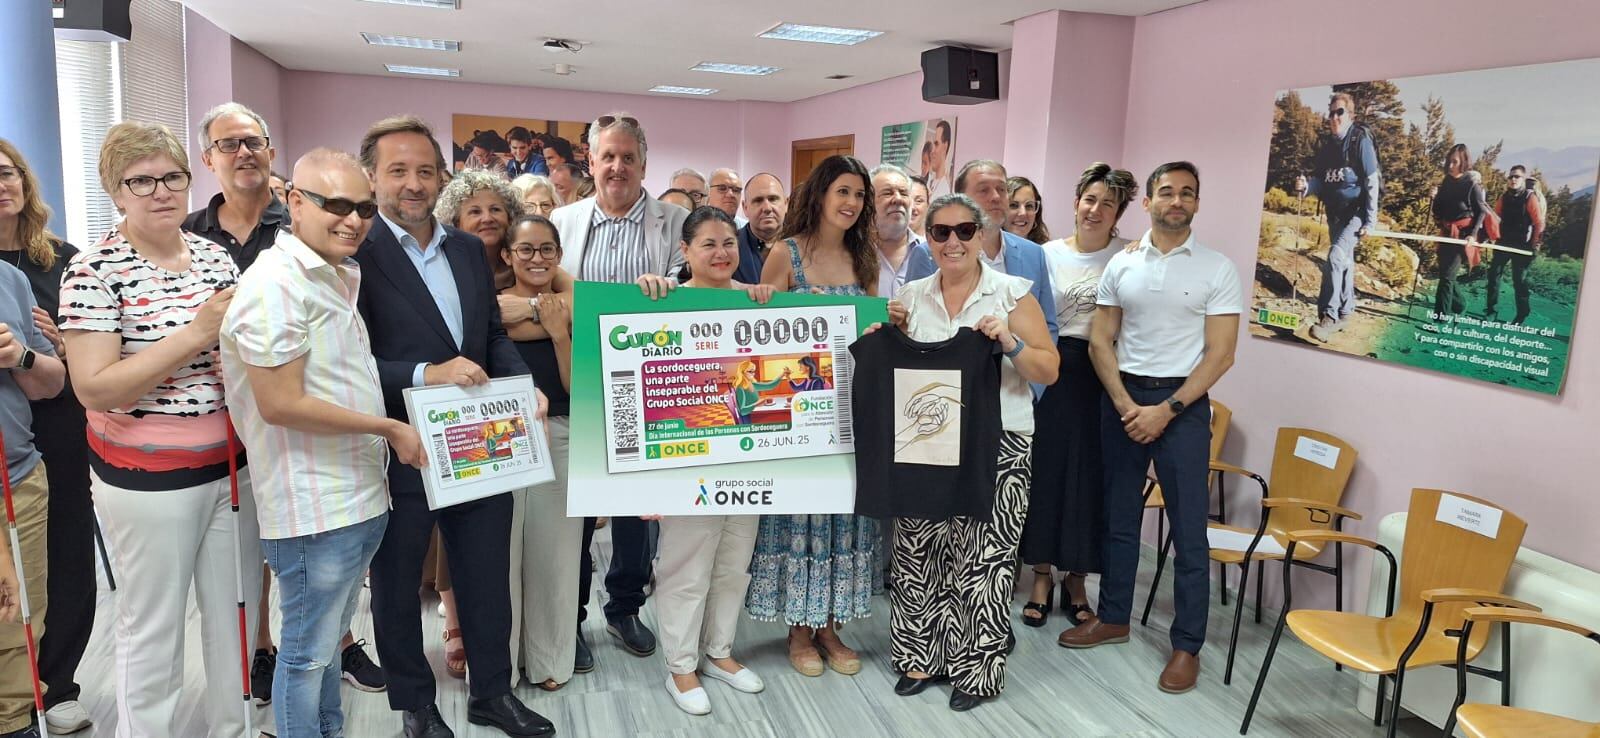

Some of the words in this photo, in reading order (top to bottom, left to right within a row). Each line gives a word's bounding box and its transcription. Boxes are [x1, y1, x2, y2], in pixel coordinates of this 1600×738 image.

[1270, 313, 1296, 326] ONCE
[1426, 310, 1439, 319] No
[1439, 312, 1453, 323] hay
[1481, 320, 1500, 328] para
[1502, 321, 1539, 335] disfrutar
[1540, 327, 1555, 337] del
[690, 322, 722, 338] 000
[733, 316, 828, 346] 00000
[1422, 323, 1440, 333] ocio,
[1442, 325, 1453, 334] de
[1453, 326, 1461, 335] la
[1462, 329, 1492, 342] cultura,
[1494, 333, 1508, 343] del
[1509, 336, 1552, 351] deporte...
[695, 341, 719, 350] SERIE
[1414, 331, 1420, 340] Y
[1420, 335, 1438, 343] para
[1439, 338, 1484, 352] compartirlo
[1485, 346, 1500, 354] con
[1502, 347, 1515, 357] los
[1516, 351, 1550, 365] amigos,
[644, 364, 656, 374] La
[657, 362, 723, 373] sordoceguera,
[1433, 350, 1448, 358] con
[1456, 353, 1468, 361] sin
[1469, 354, 1522, 372] discapacidad
[1523, 365, 1549, 377] visual
[645, 377, 663, 385] una
[665, 374, 689, 385] parte
[646, 385, 701, 397] inseparable
[703, 383, 718, 393] del
[461, 404, 476, 414] 000
[480, 398, 519, 417] 00000
[646, 399, 675, 408] Grupo
[676, 395, 704, 406] Social
[705, 394, 729, 404] ONCE
[800, 399, 834, 411] ONCE
[664, 422, 679, 430] junio
[714, 426, 740, 434] Personas
[751, 423, 788, 432] Sordoceguera
[758, 439, 770, 447] 26
[797, 435, 810, 444] 25
[664, 442, 706, 455] ONCE
[461, 467, 480, 477] ONCE
[715, 480, 744, 488] grupo
[746, 478, 773, 487] social
[714, 490, 773, 505] ONCE
